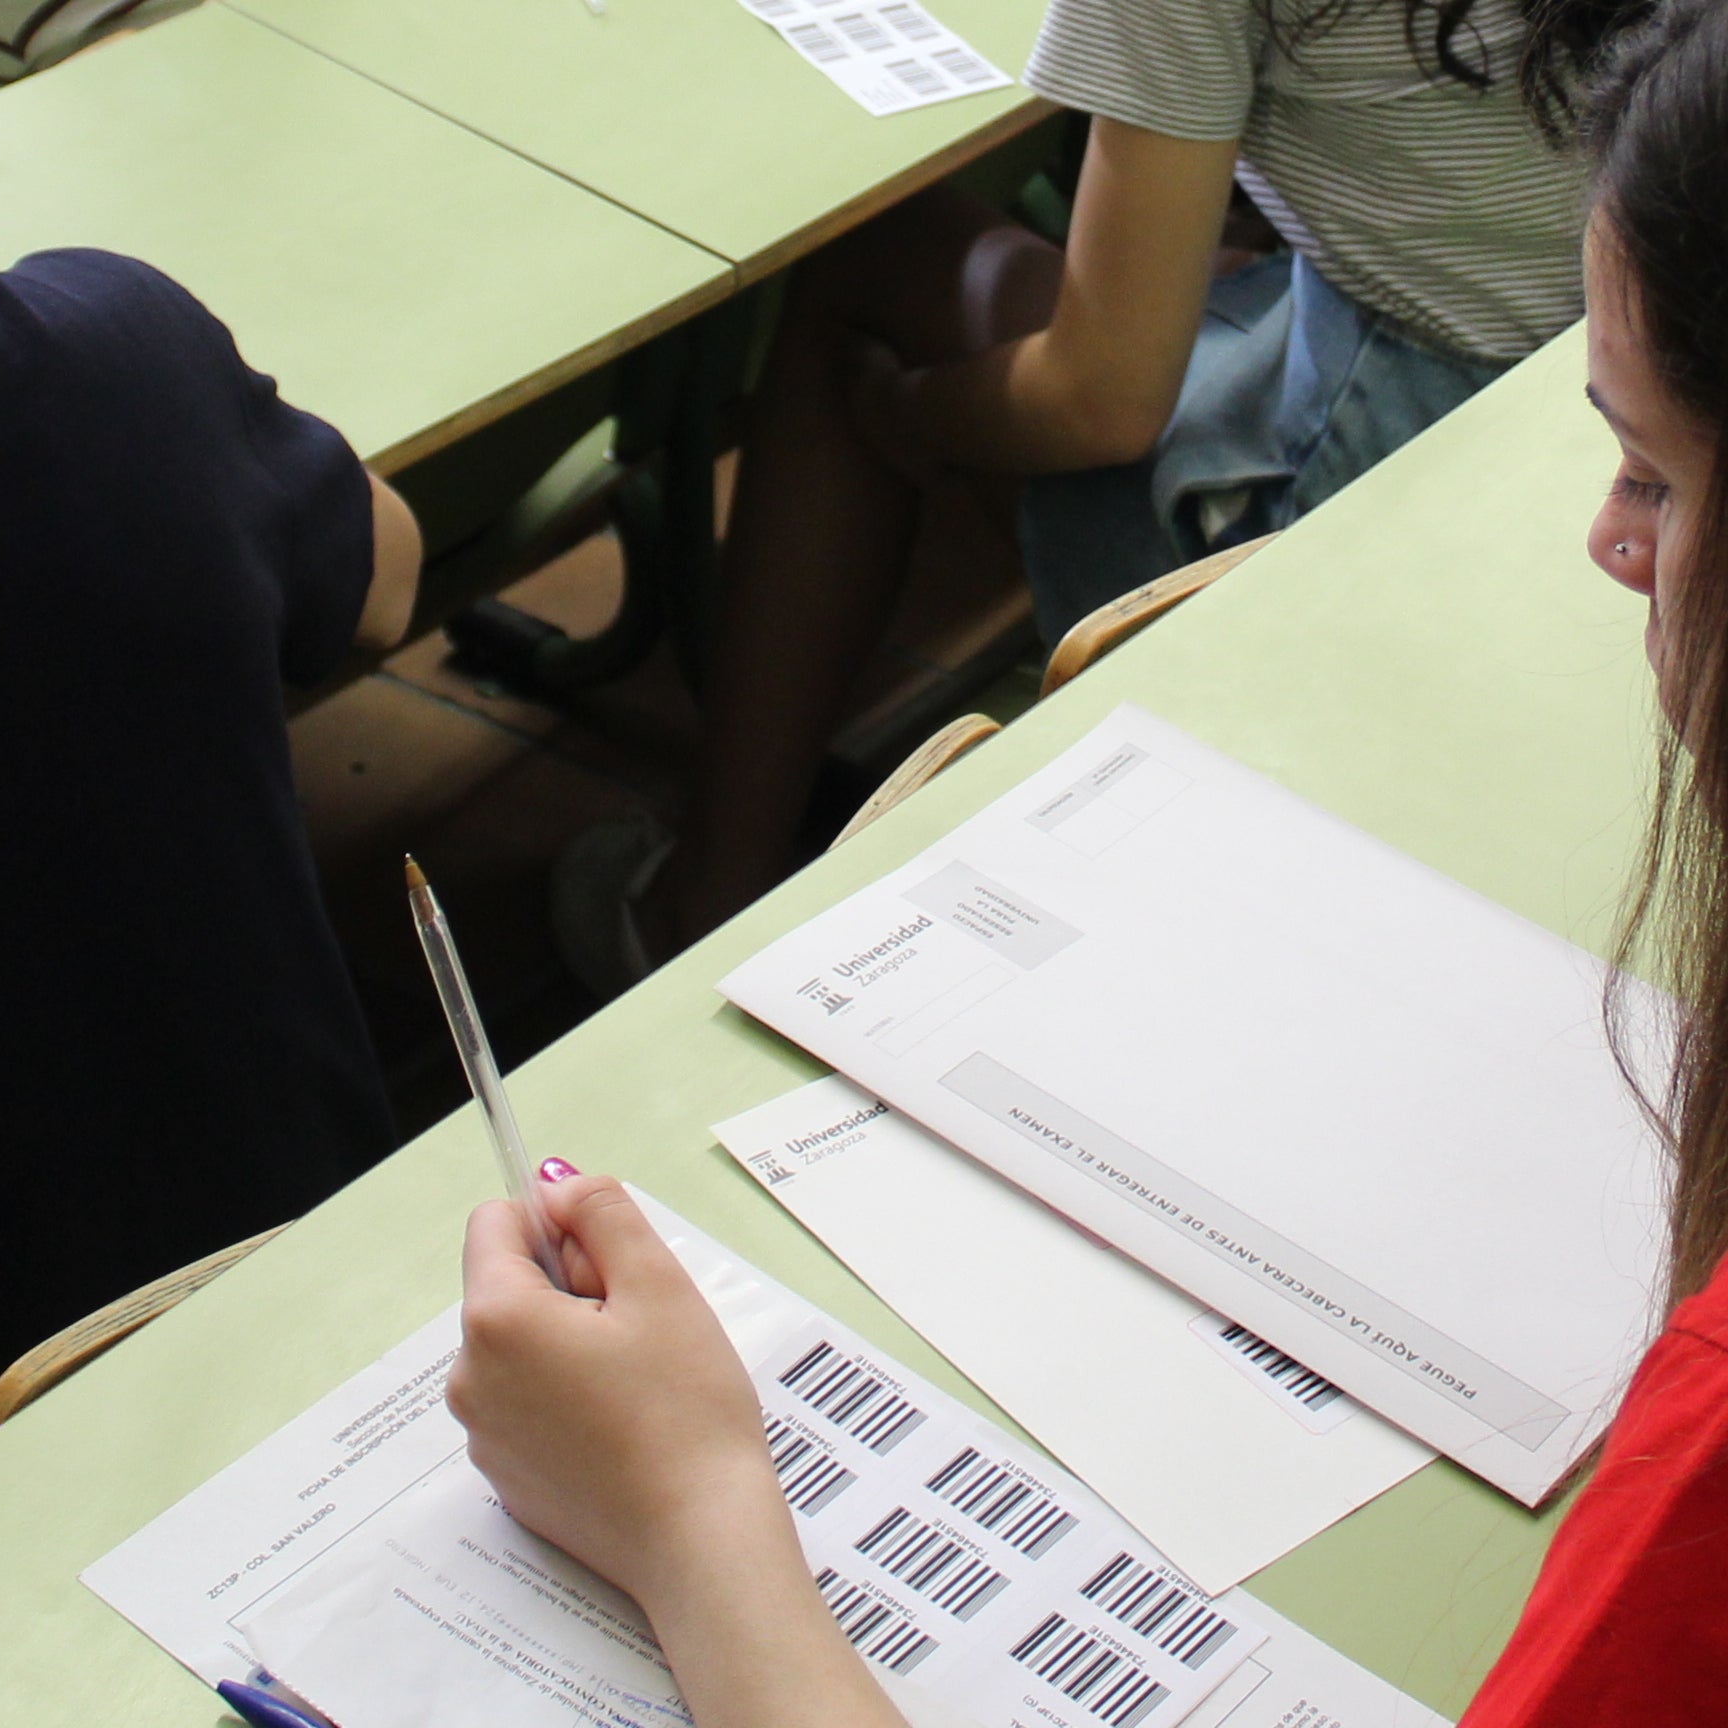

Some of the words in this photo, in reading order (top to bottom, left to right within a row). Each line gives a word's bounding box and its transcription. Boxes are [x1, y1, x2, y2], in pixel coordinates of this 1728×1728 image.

[832, 913, 934, 979] Universidad
[852, 948, 918, 988] Zaragoza
[785, 1100, 889, 1154] Universidad
[1007, 1106, 1073, 1152] EXAMEN
[800, 1131, 867, 1166] Zaragoza
[1075, 1148, 1094, 1164] EL
[1095, 1160, 1181, 1217] ENTREGAR
[1179, 1213, 1205, 1233] DE
[1205, 1228, 1262, 1265] ANTES
[1263, 1262, 1347, 1319] CABECERA
[1349, 1316, 1373, 1335] LA
[1419, 1360, 1478, 1401] PEGUE
[332, 1394, 398, 1443] UNIVERSIDAD
[396, 1383, 413, 1397] DE
[383, 1413, 395, 1424] de
[298, 1476, 331, 1501] FICHA
[328, 1464, 345, 1479] DE
[405, 1407, 428, 1422] DEL
[206, 1572, 240, 1600] ZC13P
[270, 1533, 296, 1553] SAN
[293, 1502, 337, 1535] VALERO
[458, 1536, 498, 1565] ONLINE
[393, 1586, 441, 1622] expresada
[438, 1620, 482, 1650] cantidad
[493, 1654, 539, 1687] Zaragoza
[515, 1650, 605, 1711] CONVOCATORIA
